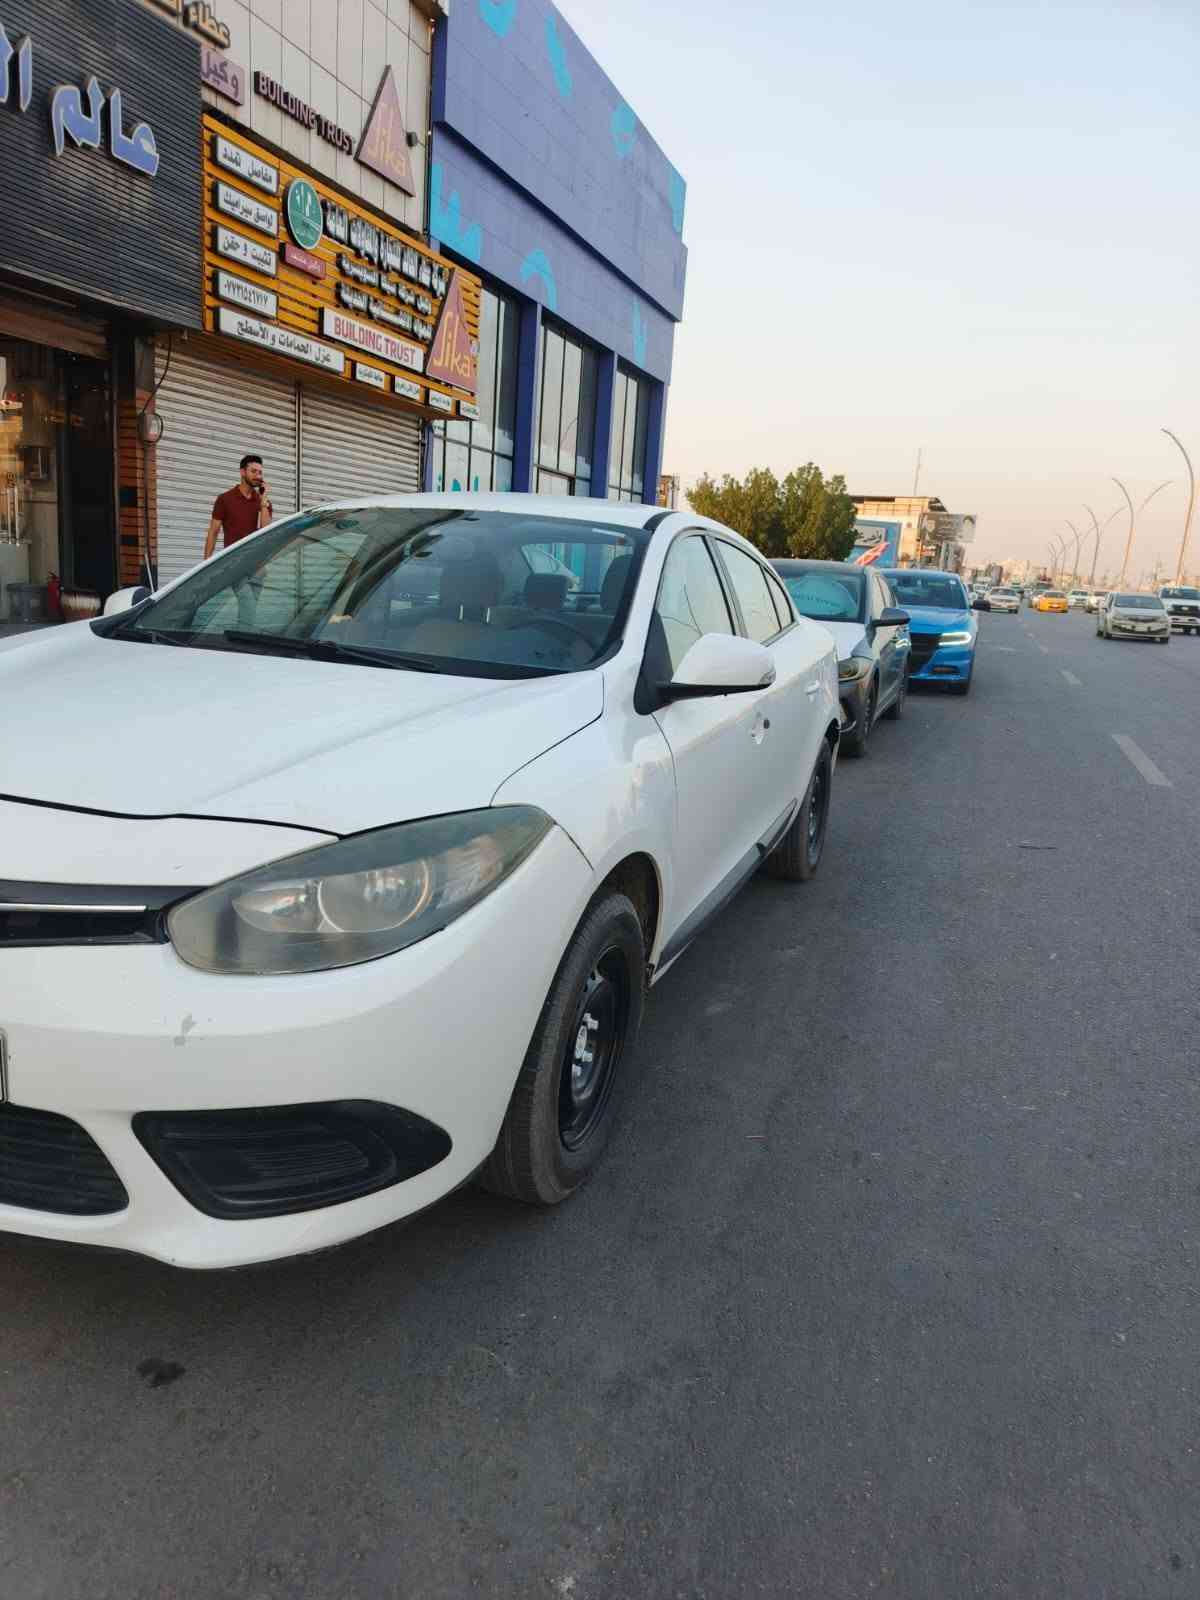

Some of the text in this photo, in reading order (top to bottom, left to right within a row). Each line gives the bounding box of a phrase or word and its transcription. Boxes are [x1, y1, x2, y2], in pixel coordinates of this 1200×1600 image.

[256, 71, 352, 155] BUILDING TRUST
[334, 316, 382, 351] BUILDING
[384, 337, 416, 366] TRUST
[432, 311, 471, 377] Sika
